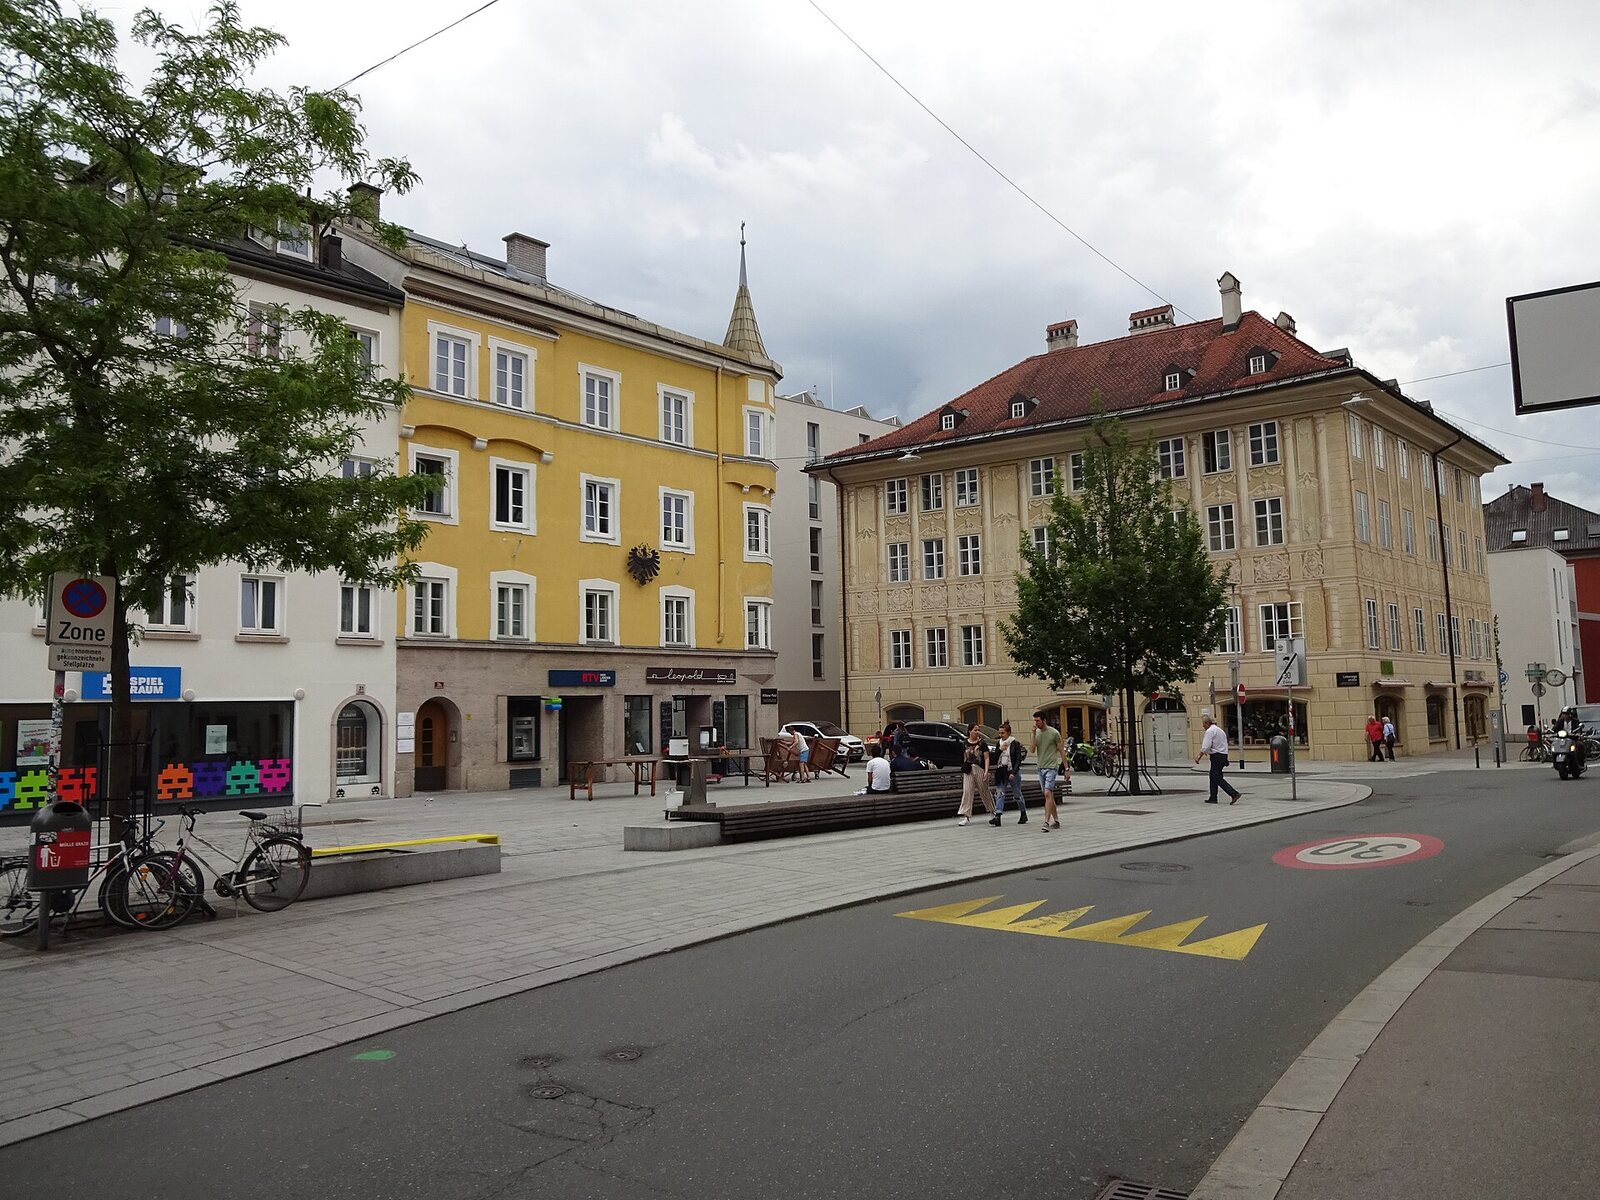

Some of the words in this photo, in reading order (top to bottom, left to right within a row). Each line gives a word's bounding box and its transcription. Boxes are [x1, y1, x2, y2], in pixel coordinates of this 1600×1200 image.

[58, 621, 105, 641] Zone
[63, 660, 95, 668] Stellplätze
[129, 677, 164, 685] SPIEL
[582, 673, 599, 682] BTV
[129, 686, 163, 694] RAUM
[1309, 841, 1407, 859] 30
